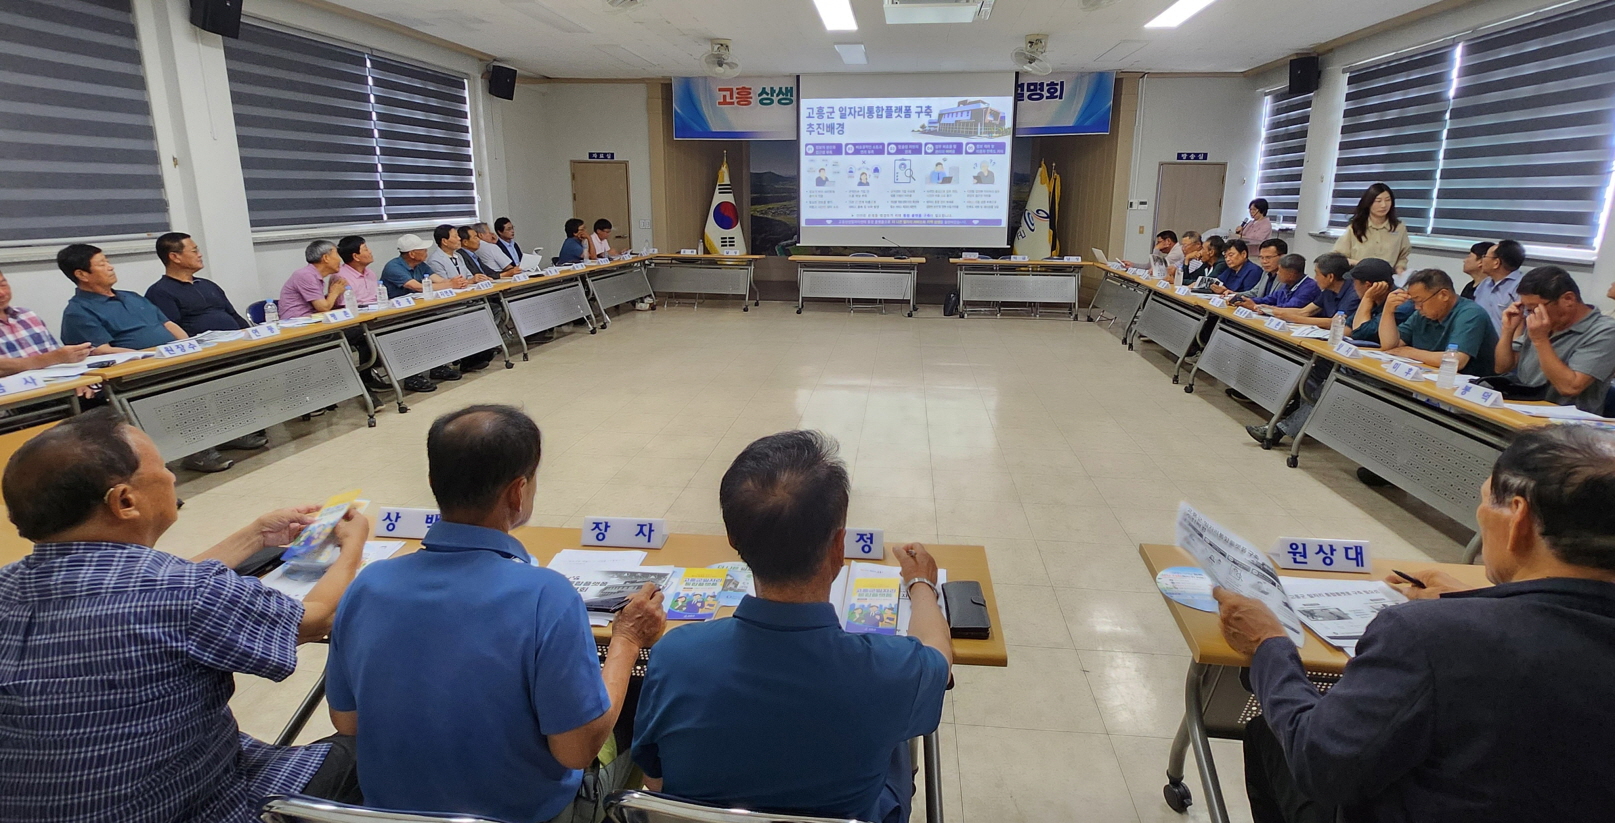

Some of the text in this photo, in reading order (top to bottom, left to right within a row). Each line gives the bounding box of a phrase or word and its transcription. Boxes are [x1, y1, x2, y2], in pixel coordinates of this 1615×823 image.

[717, 86, 753, 107] 고흥
[758, 86, 794, 106] 상생
[805, 105, 933, 120] 고흥군 일자리통합플랫폼 구축
[805, 122, 845, 136] 추진배경
[164, 342, 197, 355] 원장수
[855, 532, 874, 555] 정
[1287, 541, 1366, 568] 원상대
